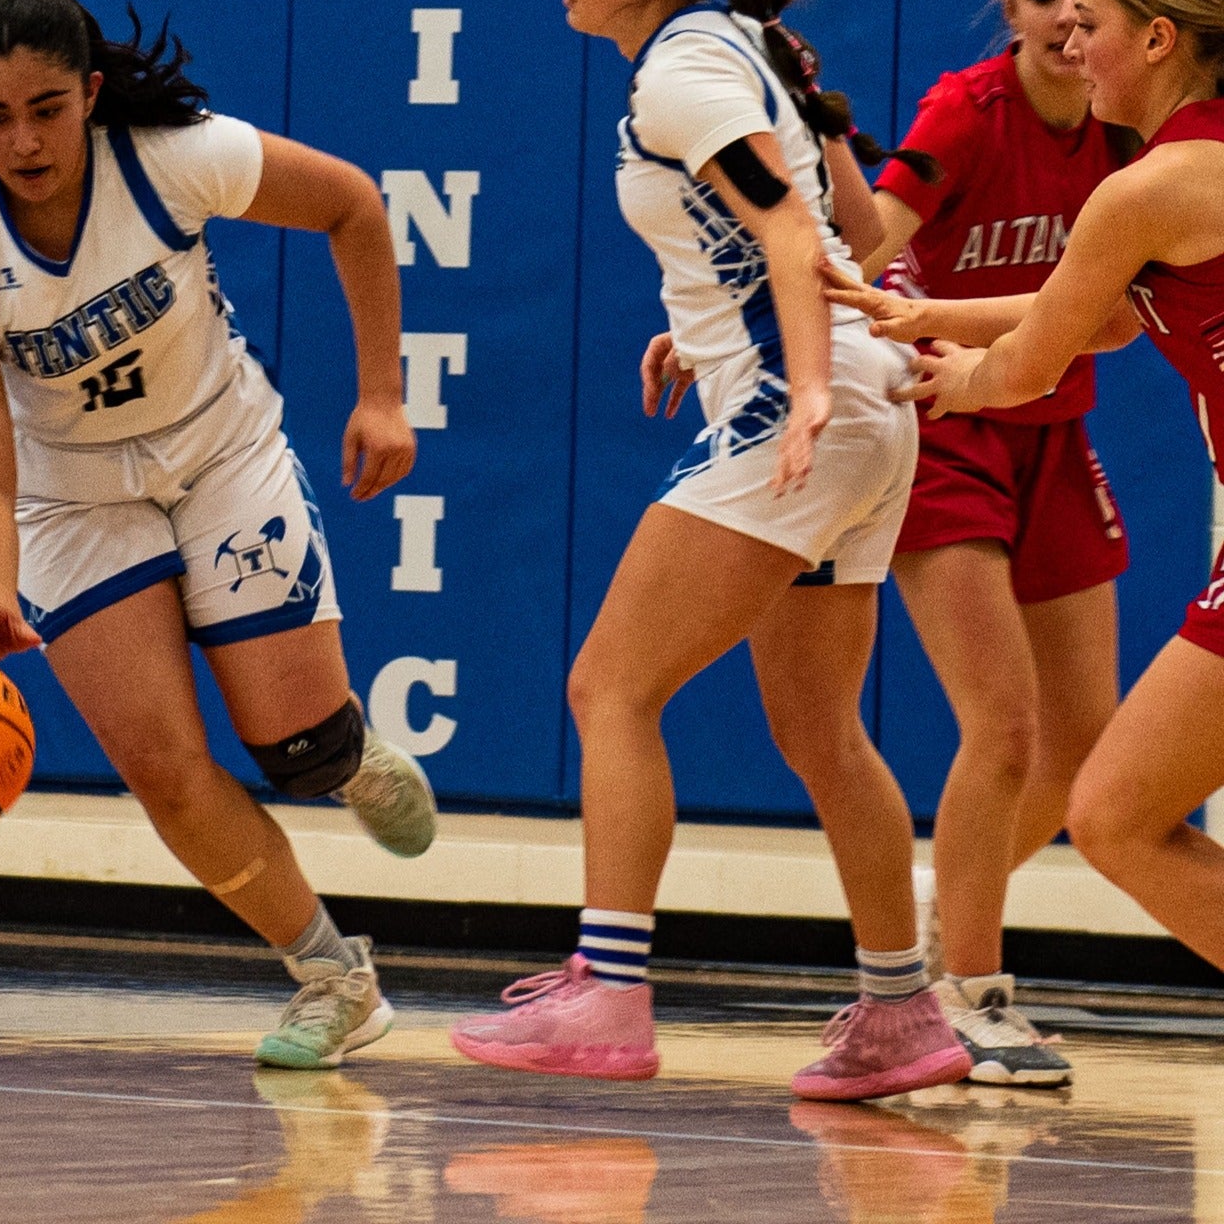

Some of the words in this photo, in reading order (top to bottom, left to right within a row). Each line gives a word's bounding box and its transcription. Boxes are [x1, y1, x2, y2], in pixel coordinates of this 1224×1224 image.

[952, 214, 1071, 273] ALTAM
[5, 261, 177, 379] TINTIC
[242, 547, 264, 572] T
